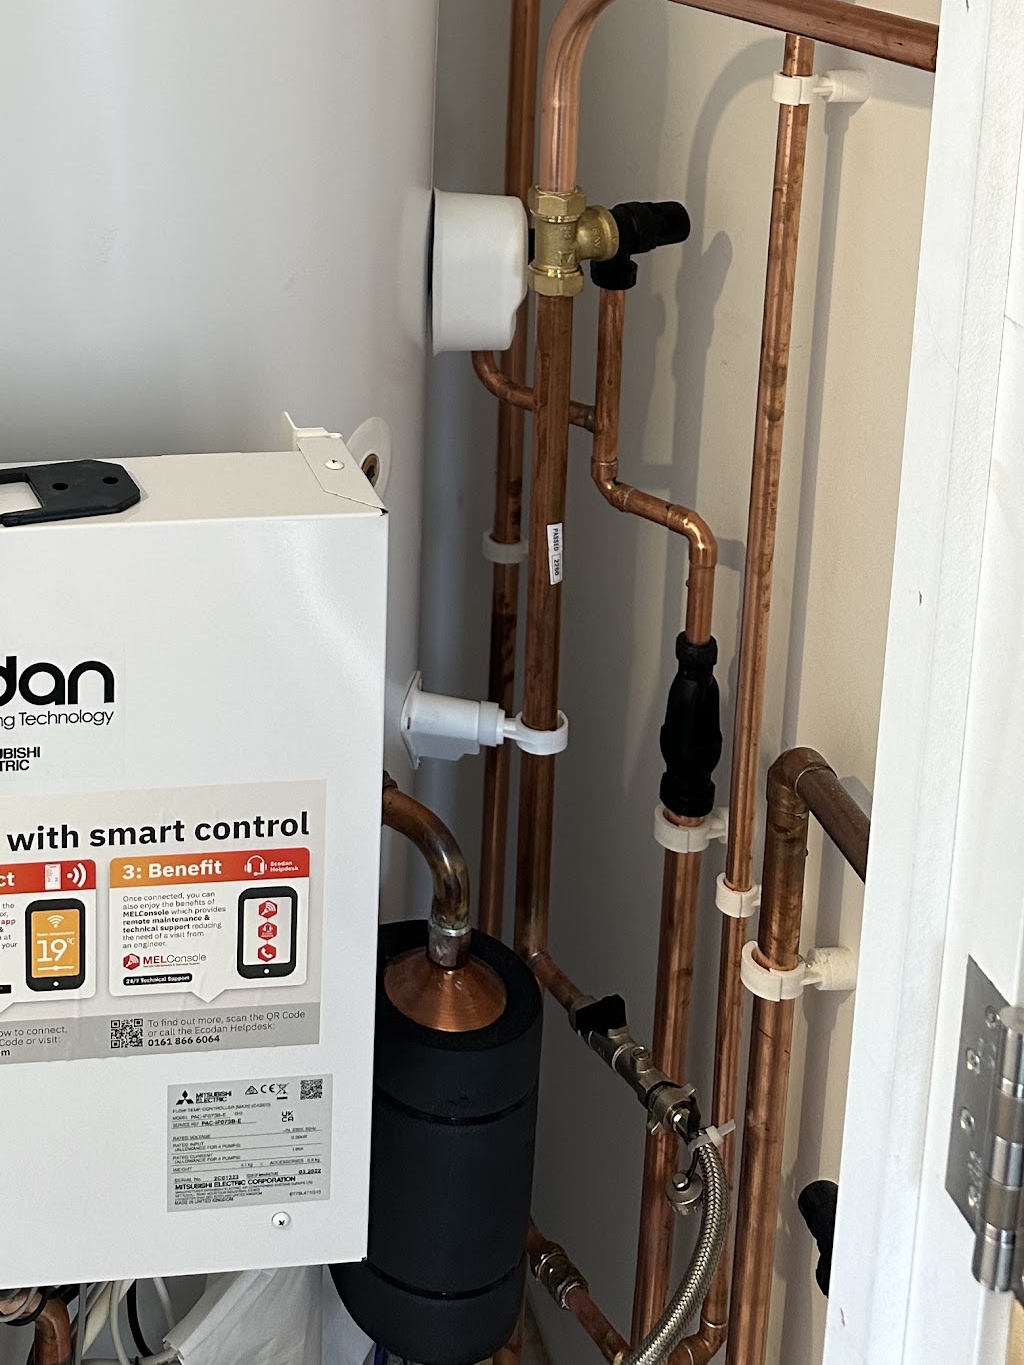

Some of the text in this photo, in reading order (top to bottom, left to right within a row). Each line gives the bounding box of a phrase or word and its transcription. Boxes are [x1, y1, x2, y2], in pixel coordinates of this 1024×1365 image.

[18, 710, 114, 725] Technology
[7, 824, 79, 852] with
[89, 820, 185, 847] smart
[195, 811, 309, 840] control
[122, 859, 222, 880] 3: Benefit
[142, 902, 160, 910] enjoy
[176, 899, 206, 907] benefits
[123, 909, 169, 918] MELConsole
[195, 906, 226, 914] provides
[1, 919, 16, 927] app
[123, 922, 222, 933] technical support reducing
[143, 954, 206, 965] MELConsole
[161, 1018, 178, 1027] find
[181, 1017, 195, 1025] out
[198, 1016, 224, 1024] more,
[226, 1014, 247, 1022] scan
[250, 1013, 264, 1021] the
[266, 1011, 279, 1021] QR
[282, 1011, 305, 1019] Code
[27, 1026, 68, 1035] connect,
[160, 1028, 175, 1036] call
[178, 1027, 192, 1035] the
[195, 1025, 228, 1034] Ecodan
[230, 1022, 275, 1032] Helpdesk:
[0, 1038, 24, 1047] Code
[38, 1036, 60, 1044] visit:
[148, 1035, 220, 1046] 0161 866 6064
